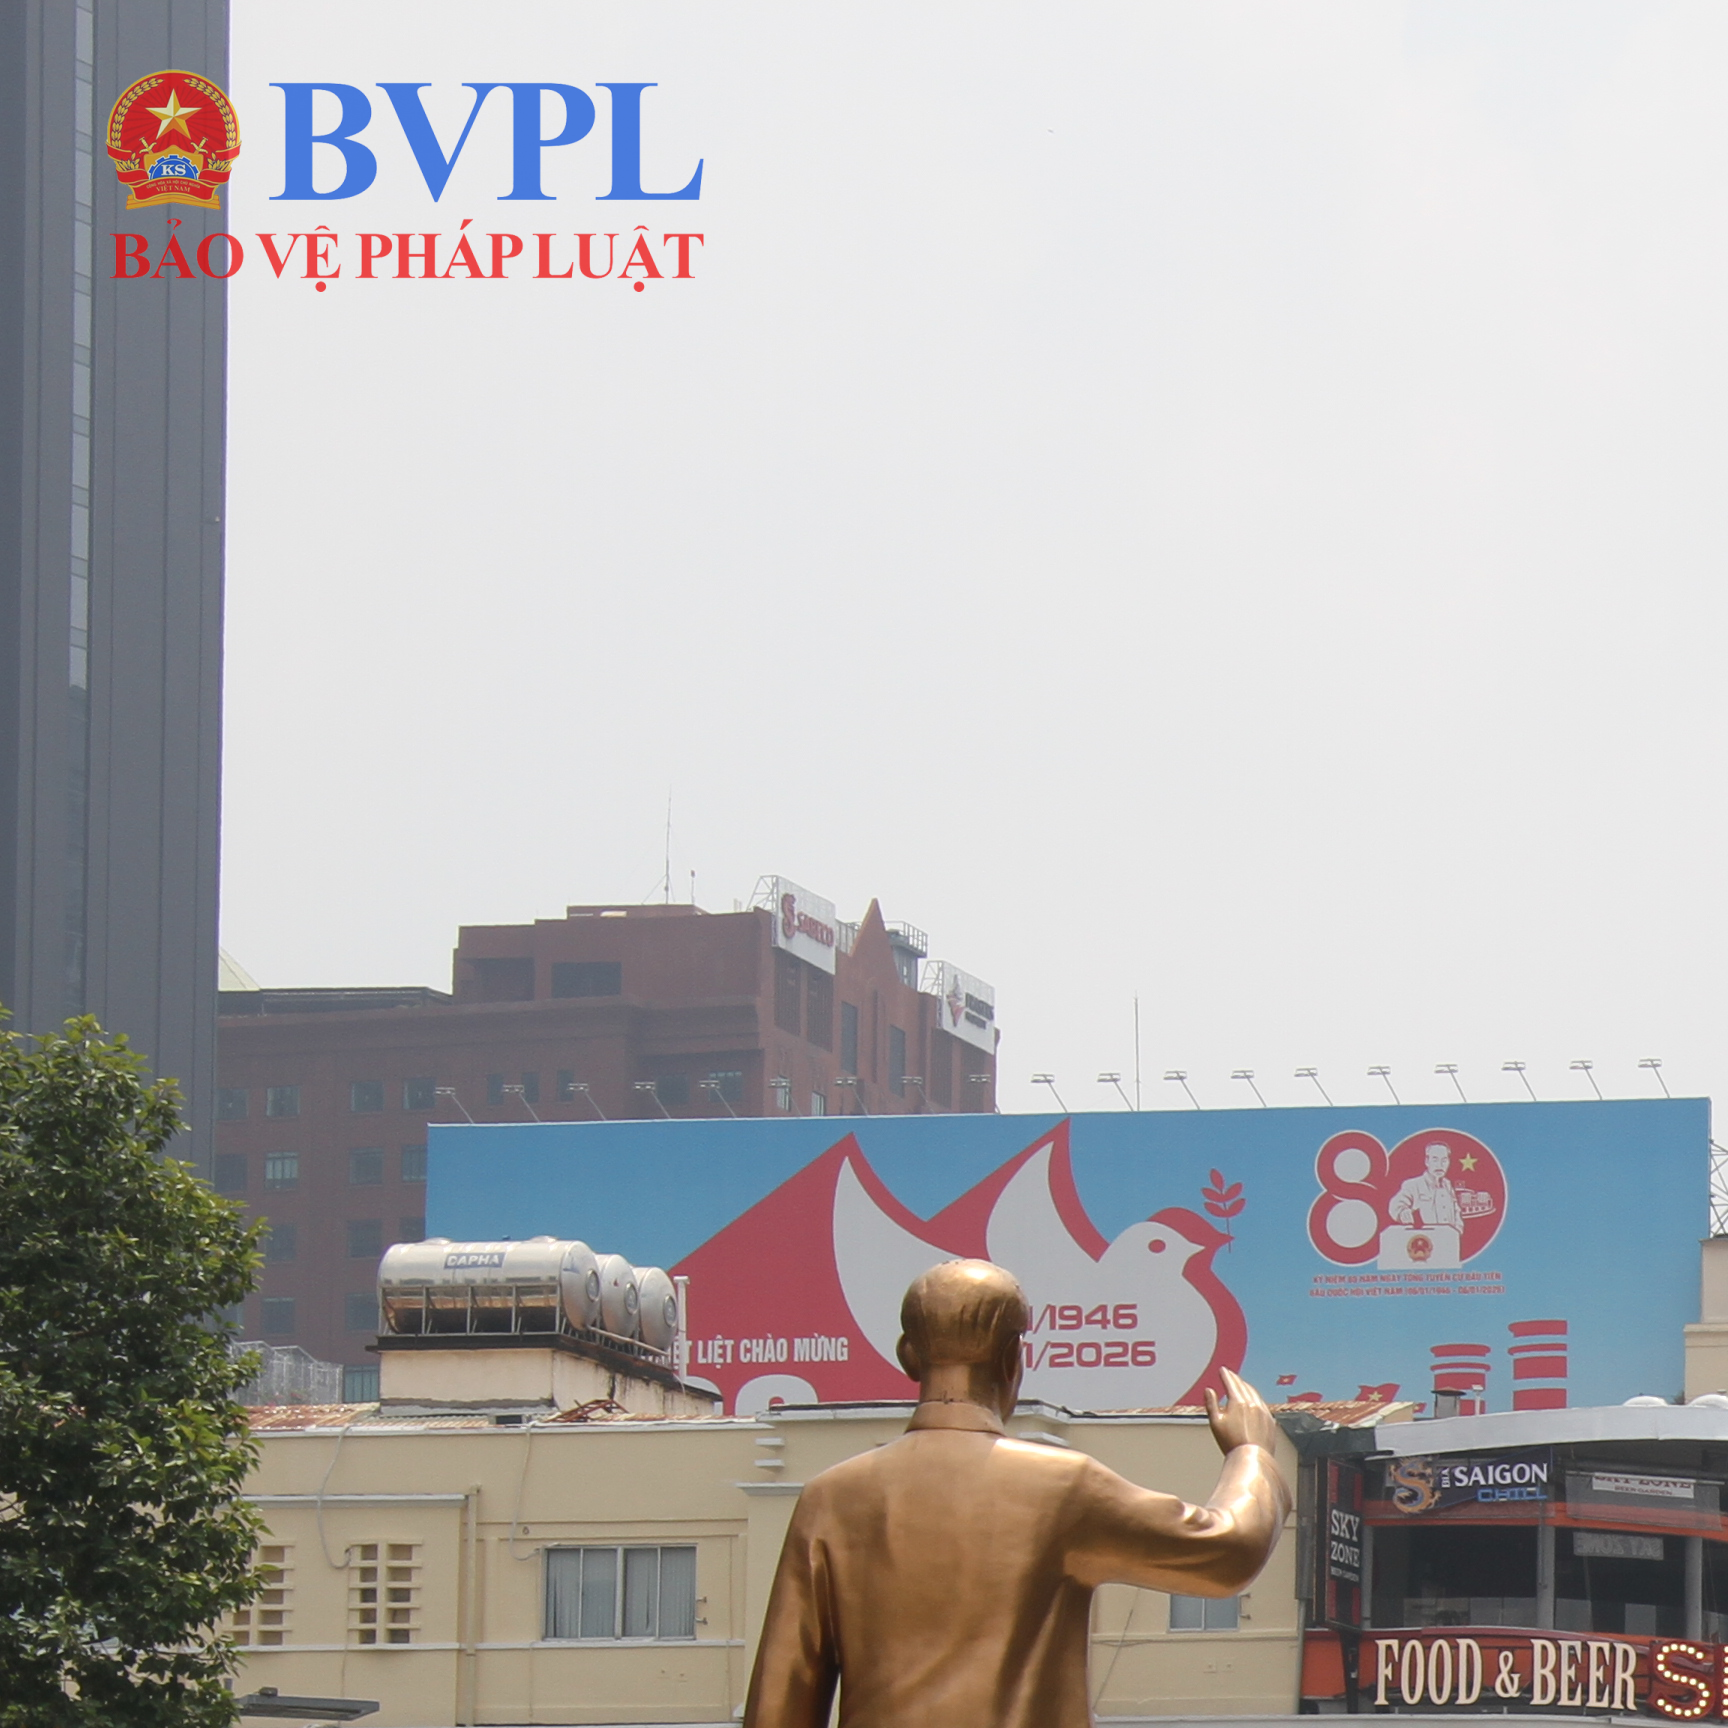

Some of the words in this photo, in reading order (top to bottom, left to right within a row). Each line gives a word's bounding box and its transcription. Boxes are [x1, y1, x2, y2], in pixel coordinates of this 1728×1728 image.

[1027, 1303, 1138, 1331] 1/1946
[697, 1333, 734, 1370] LIỆT
[740, 1333, 790, 1364] CHÀO
[794, 1332, 849, 1363] MỪNG
[1024, 1341, 1157, 1369] 1/2026
[1454, 1462, 1548, 1487] SAIGON
[1331, 1509, 1360, 1542] SKY
[1331, 1540, 1360, 1569] ZONE
[1374, 1637, 1484, 1706] FOOD
[1494, 1650, 1521, 1698] &
[1529, 1638, 1637, 1710] BEER
